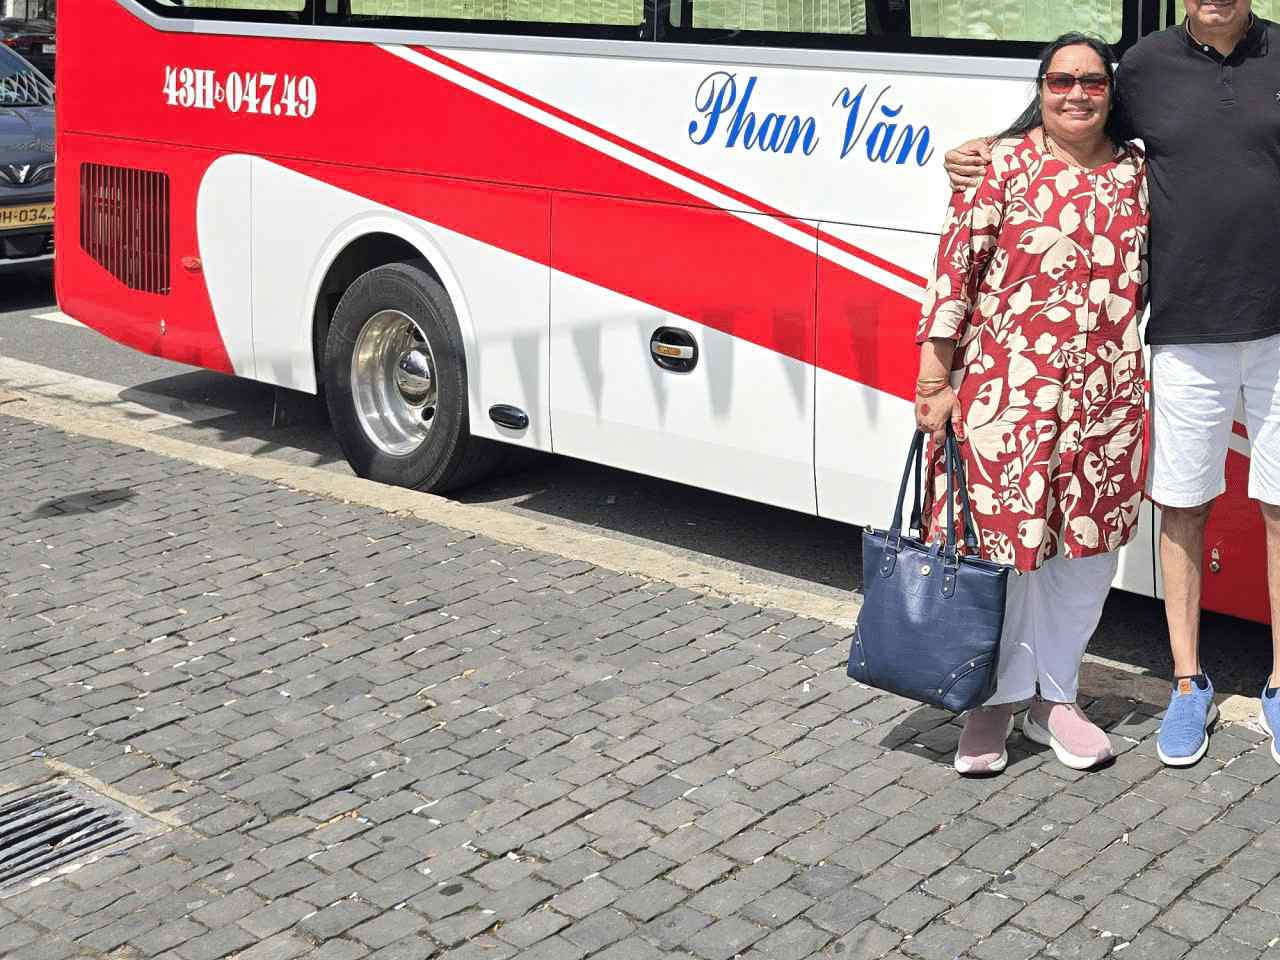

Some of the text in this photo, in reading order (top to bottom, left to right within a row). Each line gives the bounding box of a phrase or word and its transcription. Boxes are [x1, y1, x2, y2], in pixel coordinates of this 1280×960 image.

[688, 70, 935, 168] Phan Văn
[0, 207, 56, 224] H-034.
